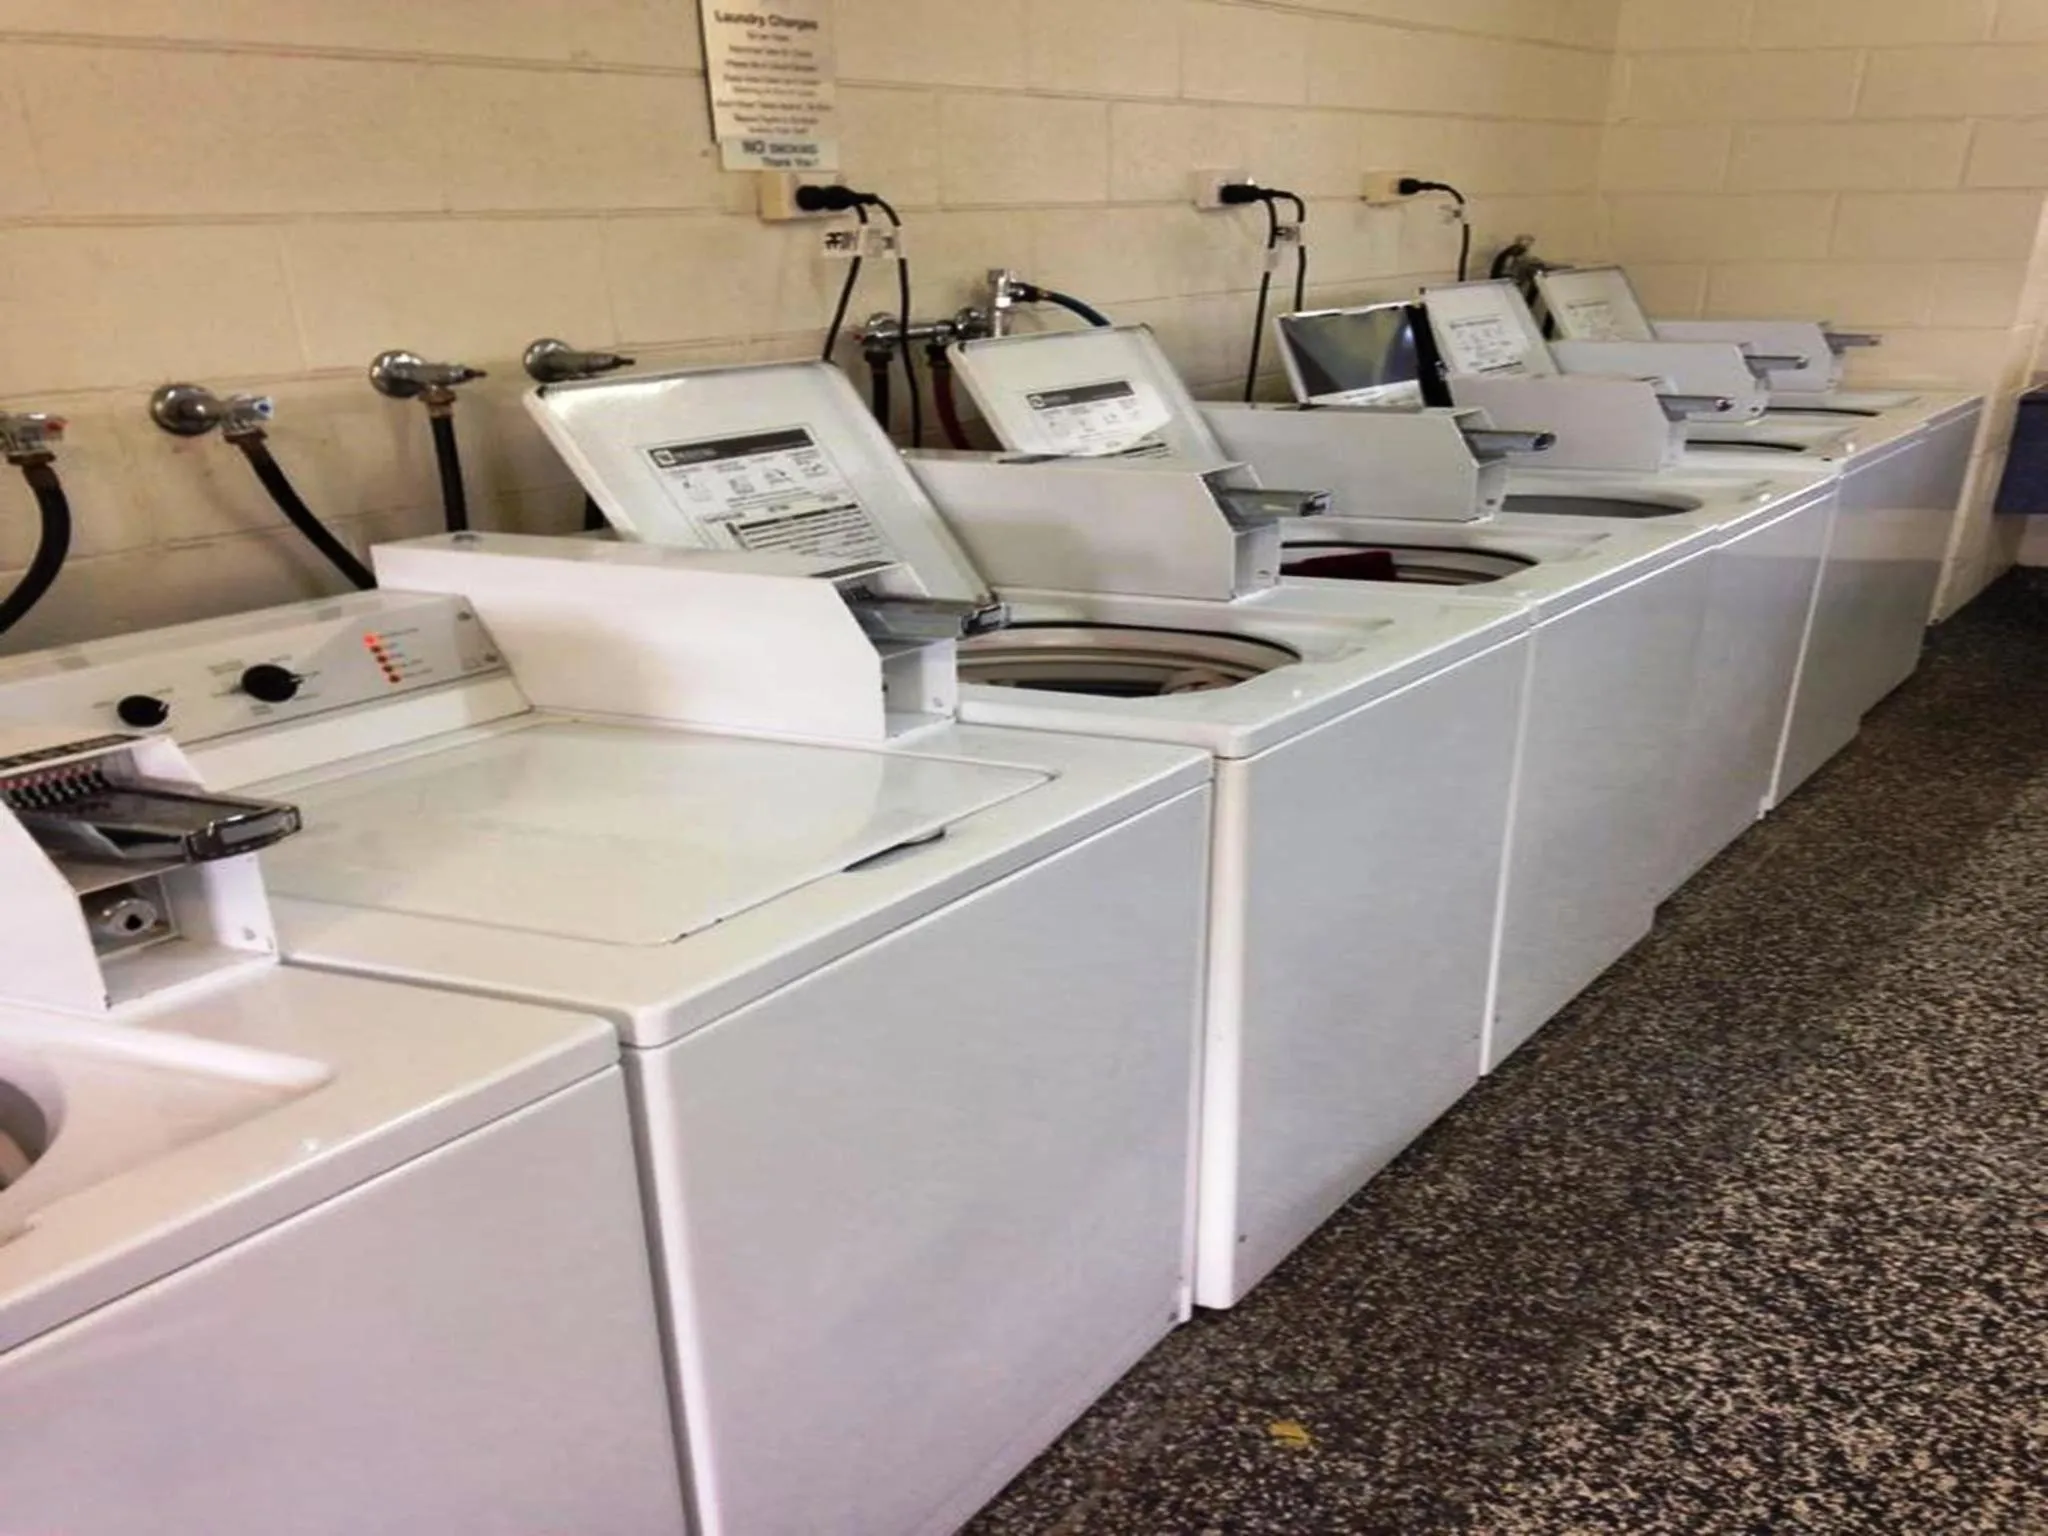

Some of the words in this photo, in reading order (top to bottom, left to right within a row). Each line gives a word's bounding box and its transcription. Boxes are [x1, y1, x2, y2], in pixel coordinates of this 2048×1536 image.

[713, 9, 766, 28] Laundry
[768, 13, 819, 32] Charges
[741, 139, 766, 155] NO
